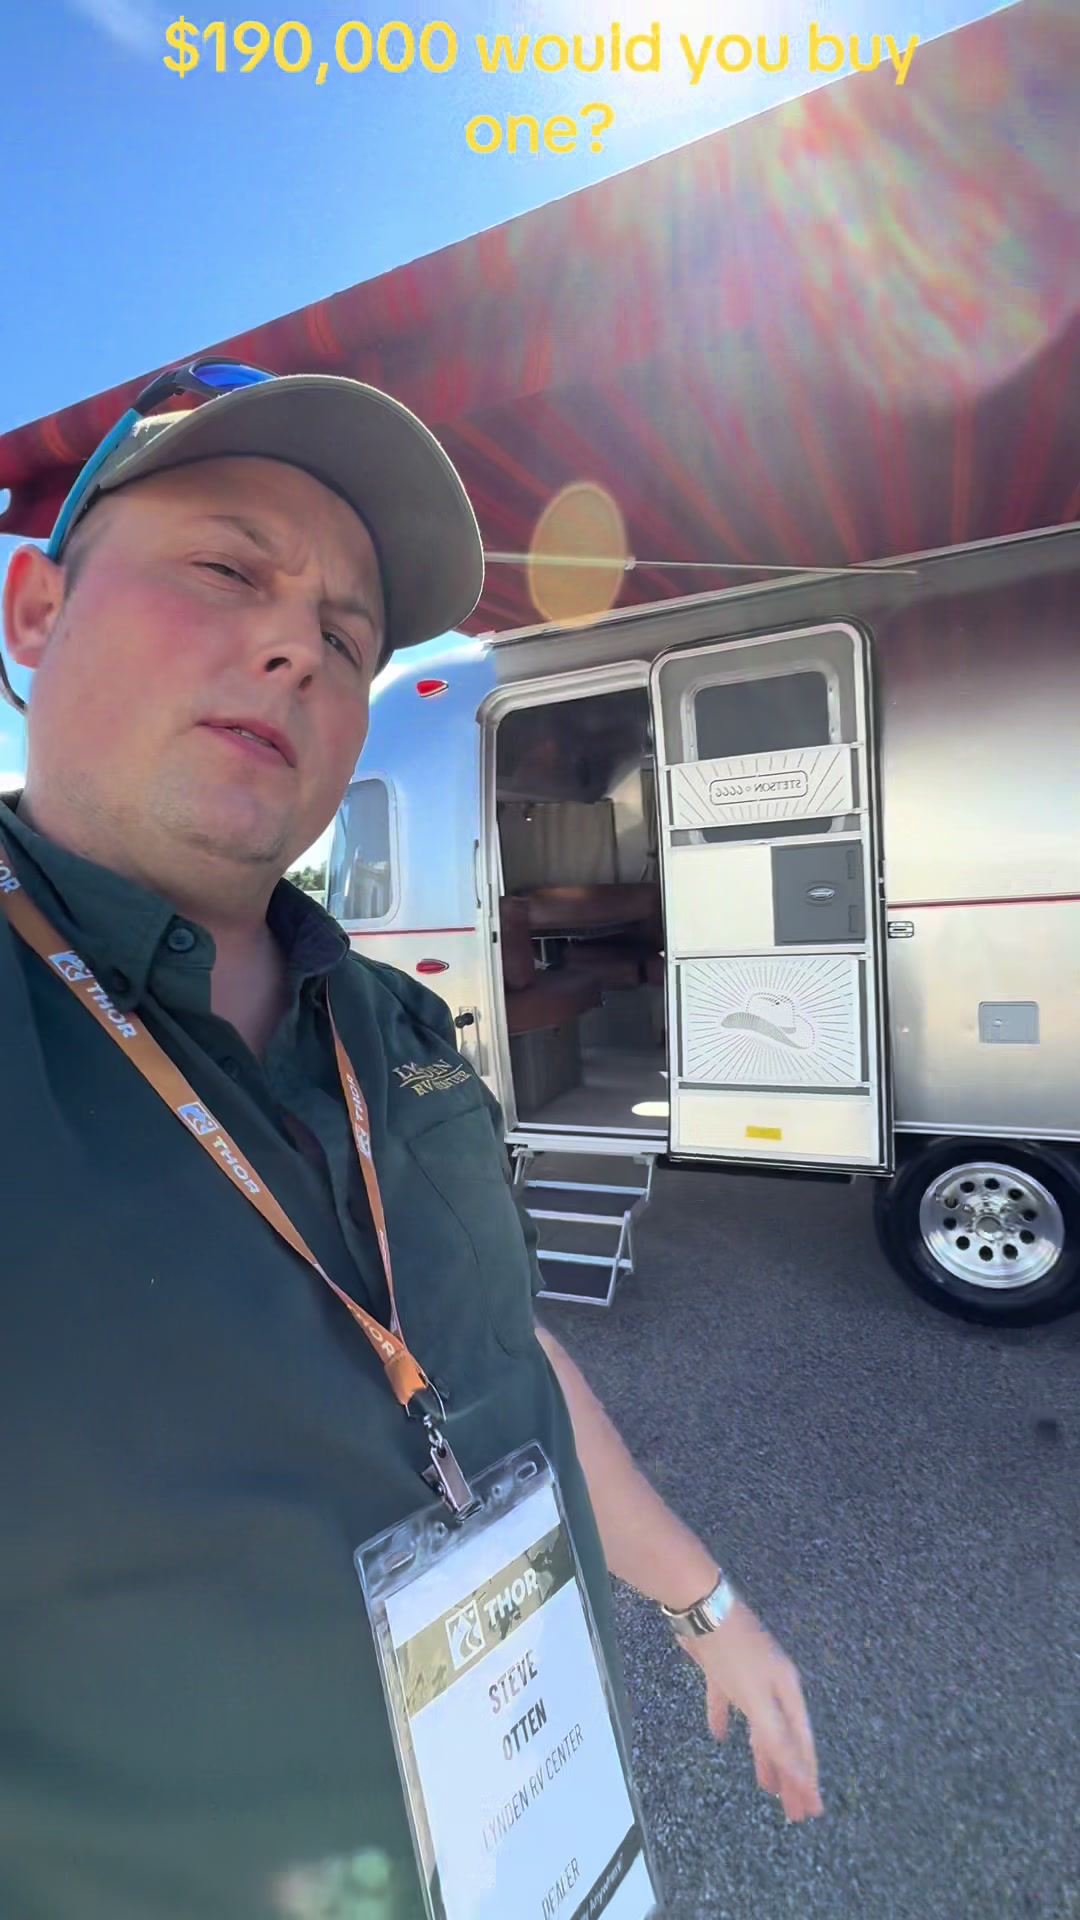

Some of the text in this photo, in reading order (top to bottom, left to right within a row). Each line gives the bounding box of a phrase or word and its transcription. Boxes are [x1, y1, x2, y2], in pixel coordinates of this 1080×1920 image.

[86, 982, 137, 1038] THOR
[411, 1079, 434, 1096] RV
[213, 1135, 260, 1194] THOR
[483, 1567, 538, 1625] THOR
[488, 1648, 538, 1715] STEVE
[503, 1698, 548, 1761] OTTEN
[482, 1722, 585, 1853] LYNDEN RV CENTER
